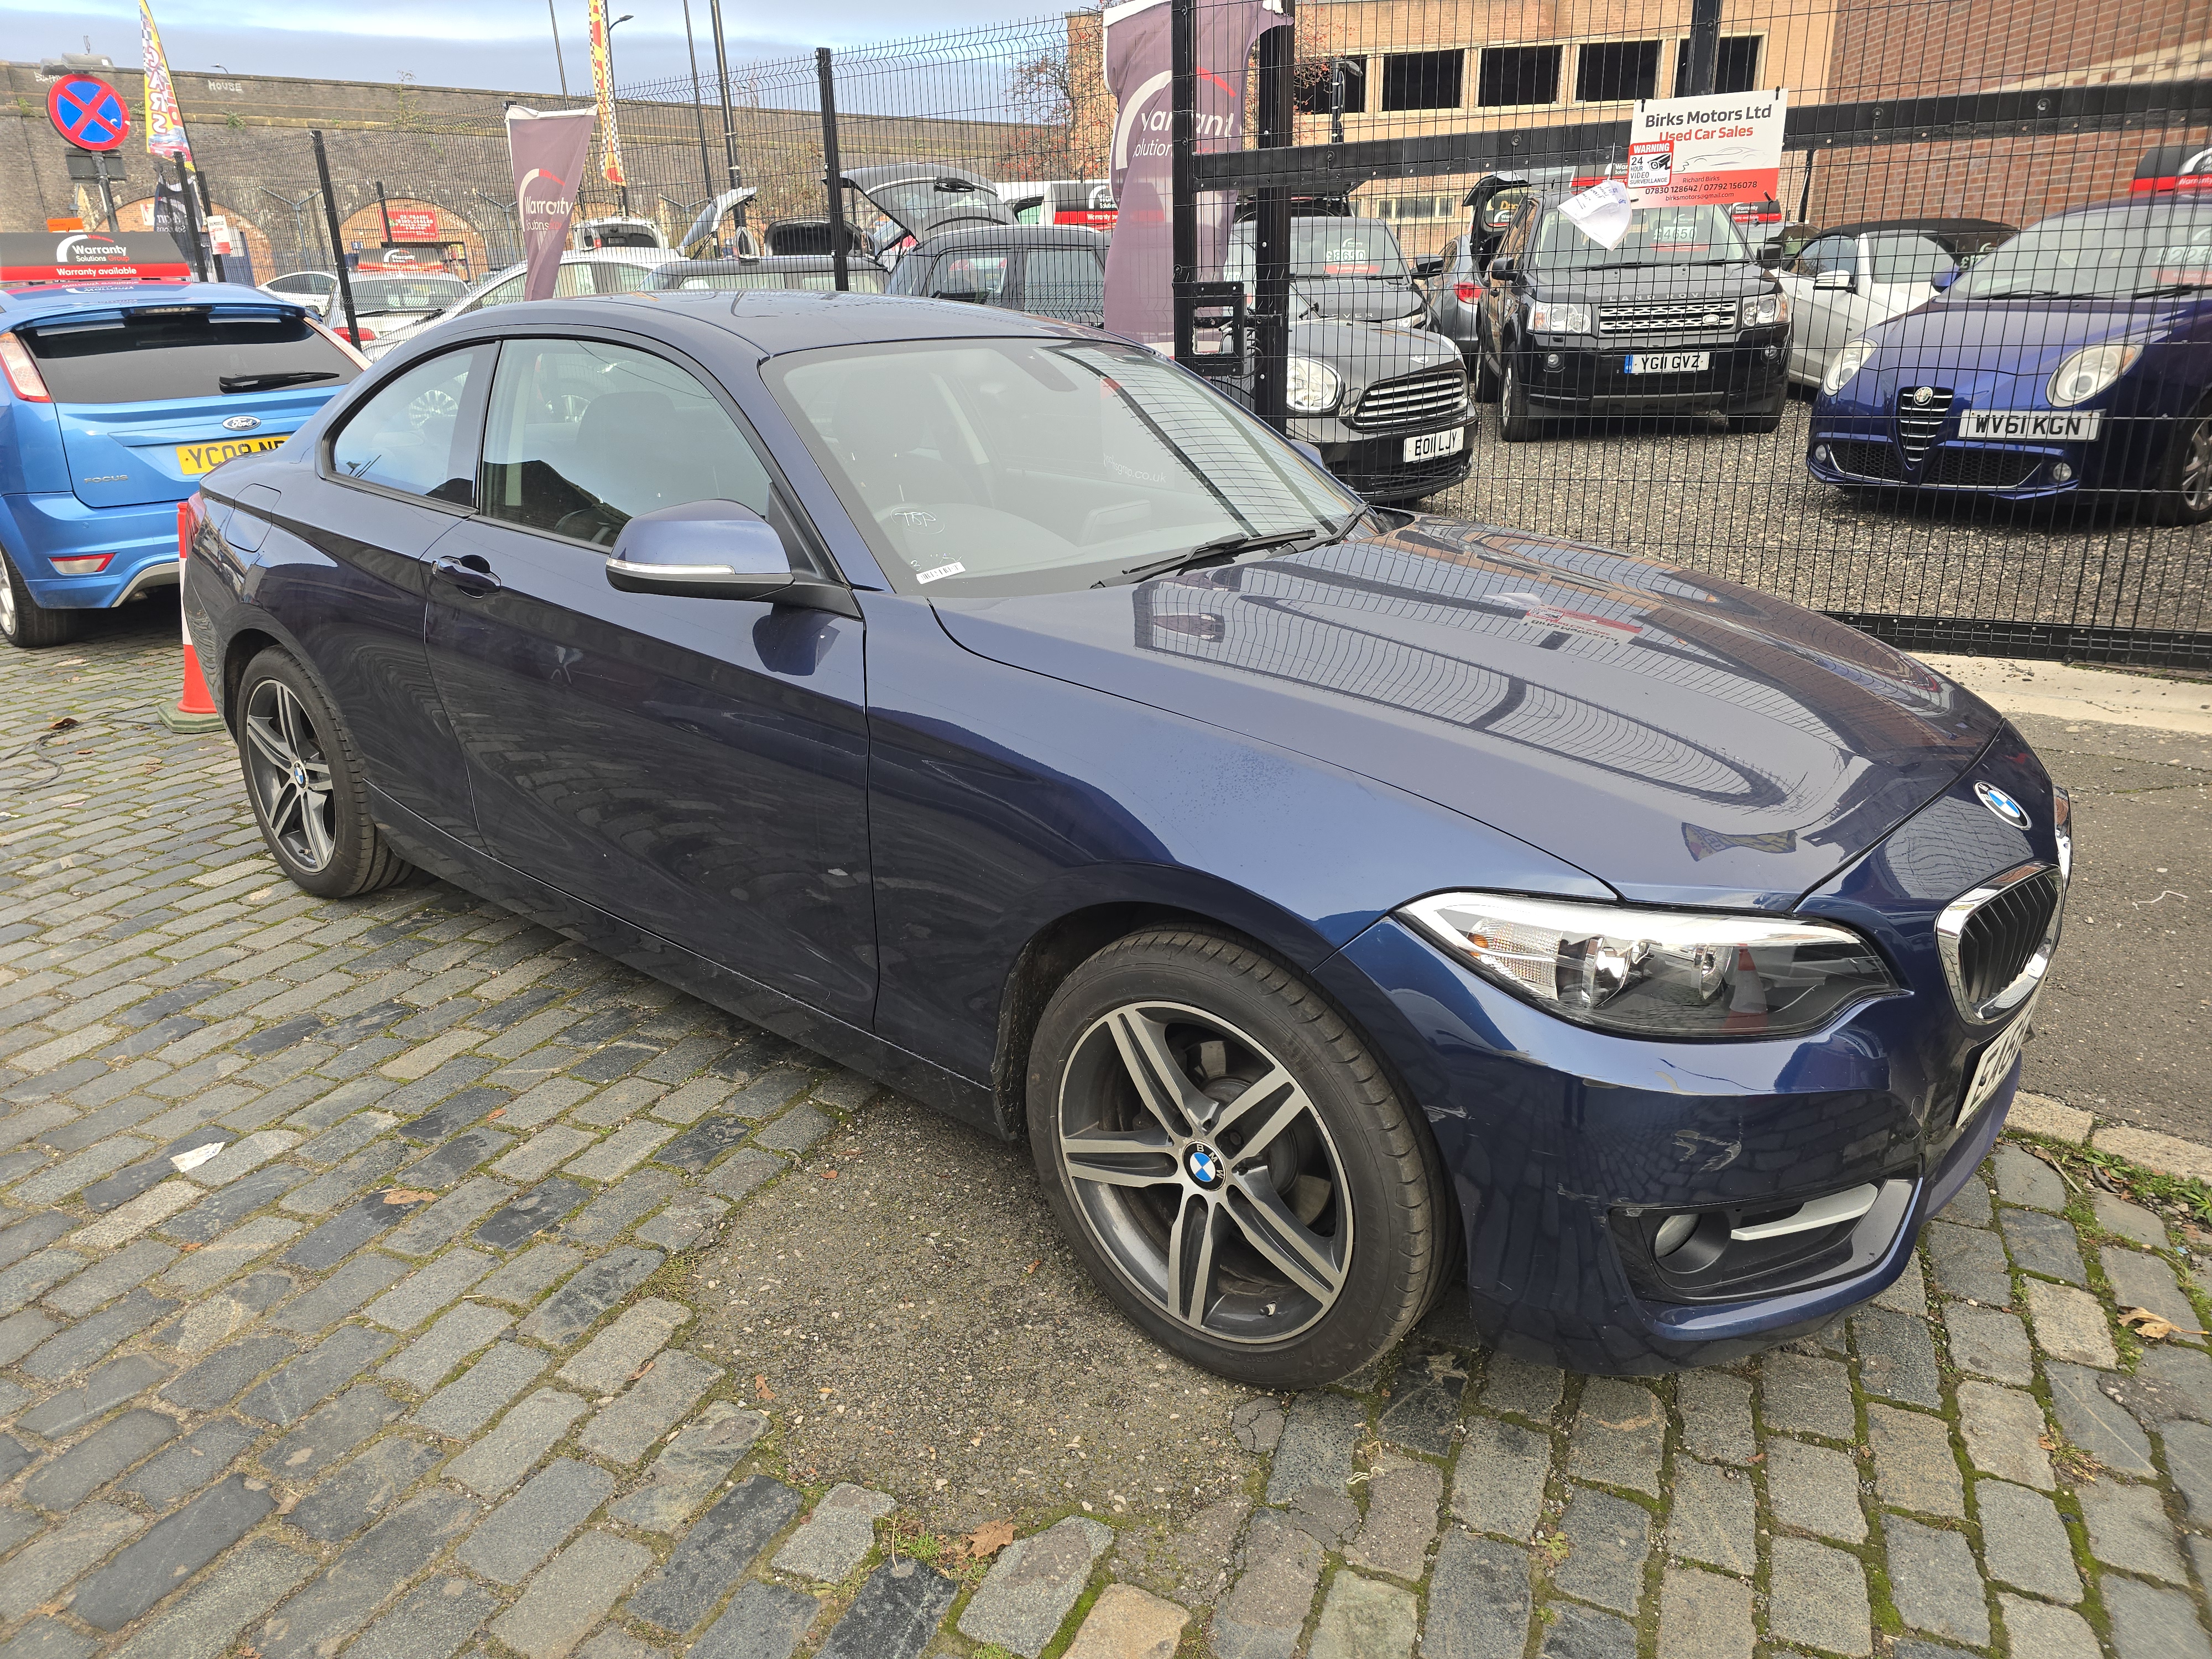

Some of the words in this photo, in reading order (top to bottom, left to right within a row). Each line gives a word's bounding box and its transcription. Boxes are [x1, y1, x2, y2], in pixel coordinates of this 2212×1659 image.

[1645, 112, 1684, 128] Birks
[1687, 109, 1743, 124] Motors
[1746, 104, 1772, 119] Ltd
[1660, 129, 1692, 141] Used
[1694, 128, 1716, 140] Car
[1718, 126, 1753, 138] Sales
[1634, 143, 1670, 154] WARNING
[1631, 156, 1644, 166] 24
[1670, 185, 1698, 193] 128642
[1704, 182, 1728, 191] 07792
[1729, 181, 1757, 190] 156078
[1665, 192, 1734, 201] birksmotors@gmail.com
[1653, 228, 1696, 240] £4650
[72, 245, 127, 257] Warranty
[1326, 251, 1365, 262] £8650
[56, 268, 96, 276] Warranty
[98, 267, 137, 275] available
[1666, 291, 1723, 300] ROVER
[1641, 357, 1667, 370] YG11
[1672, 355, 1700, 369] GVZ
[231, 418, 253, 427] Ford
[1975, 414, 2026, 435] WV61
[2032, 416, 2081, 436] KGN
[84, 474, 128, 484] FOCUS
